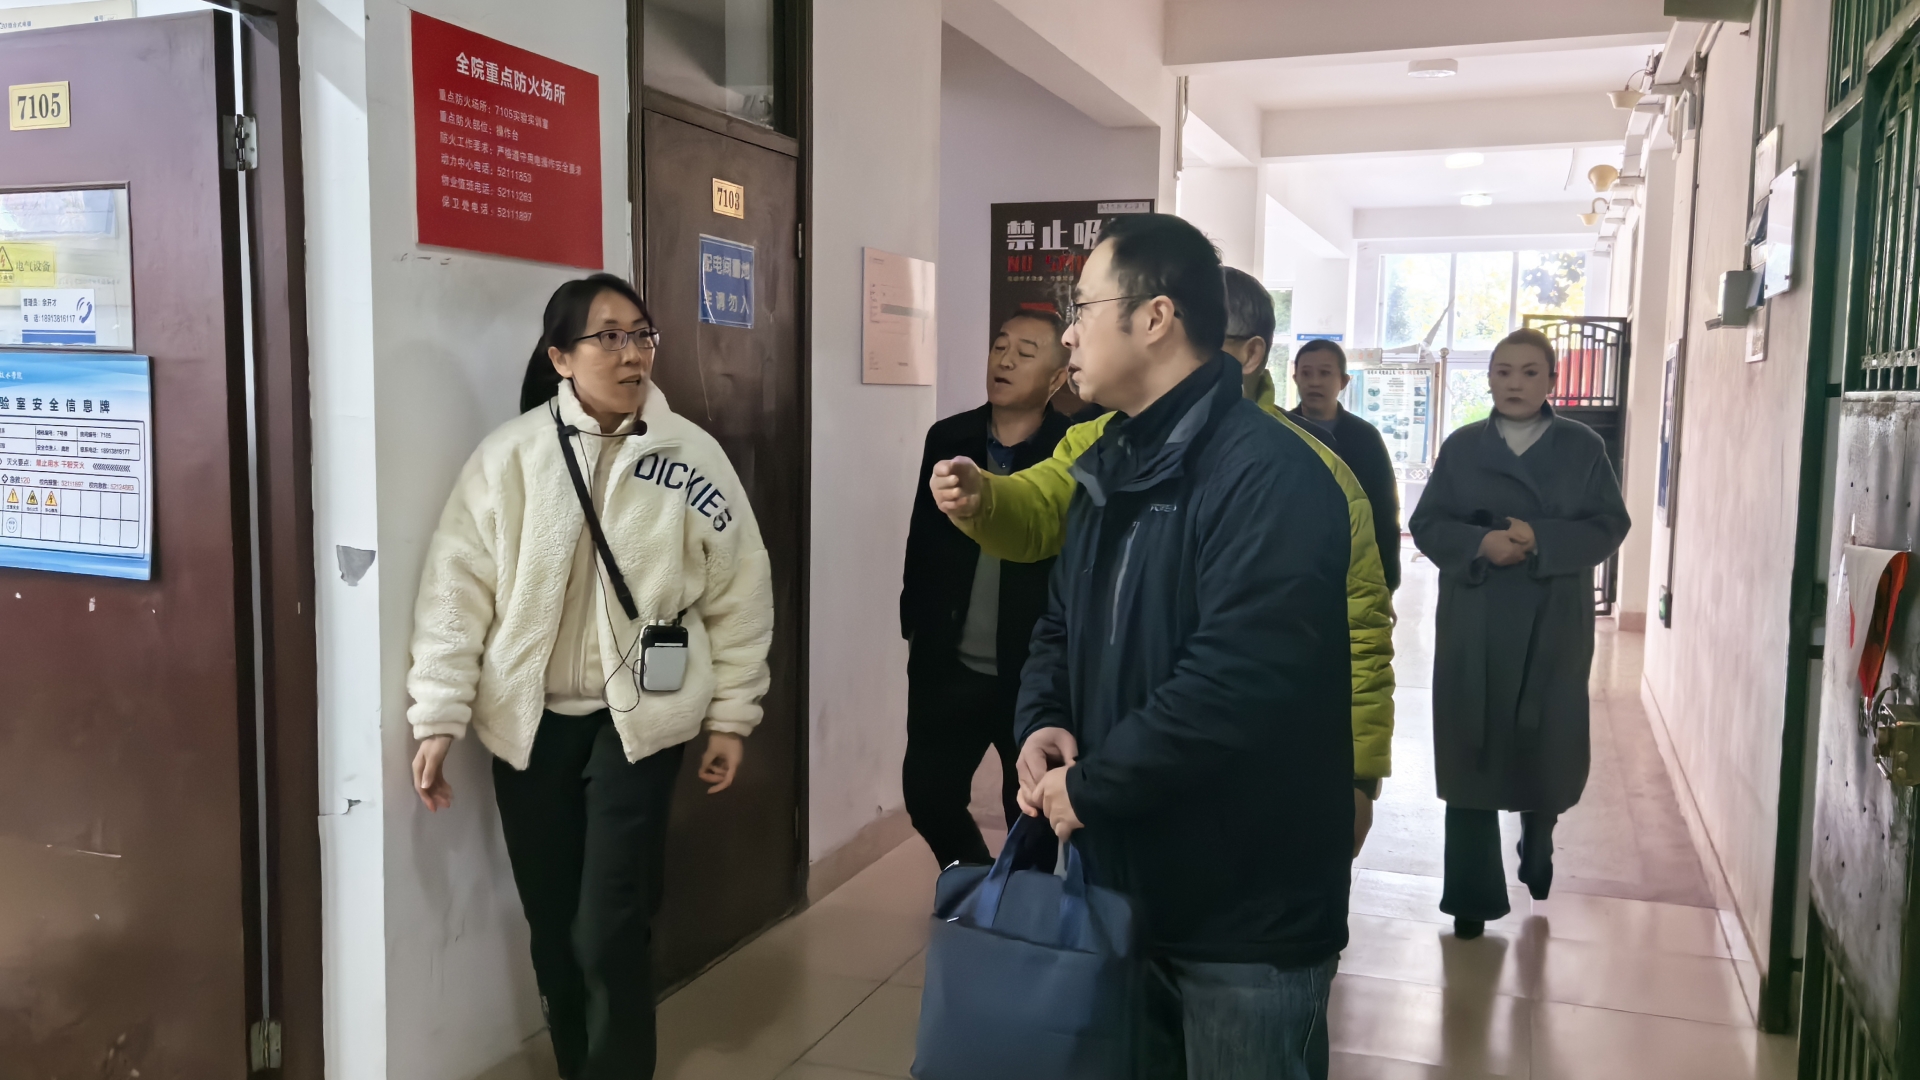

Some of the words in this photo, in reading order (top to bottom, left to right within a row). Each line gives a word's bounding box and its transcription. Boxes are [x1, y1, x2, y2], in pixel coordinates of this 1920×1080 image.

[456, 51, 566, 106] 全院重点防火场所
[17, 92, 61, 120] 7105
[717, 187, 740, 211] 7103
[16, 261, 51, 272] 电气设备
[1008, 255, 1033, 272] NO
[634, 452, 732, 532] DICKIES
